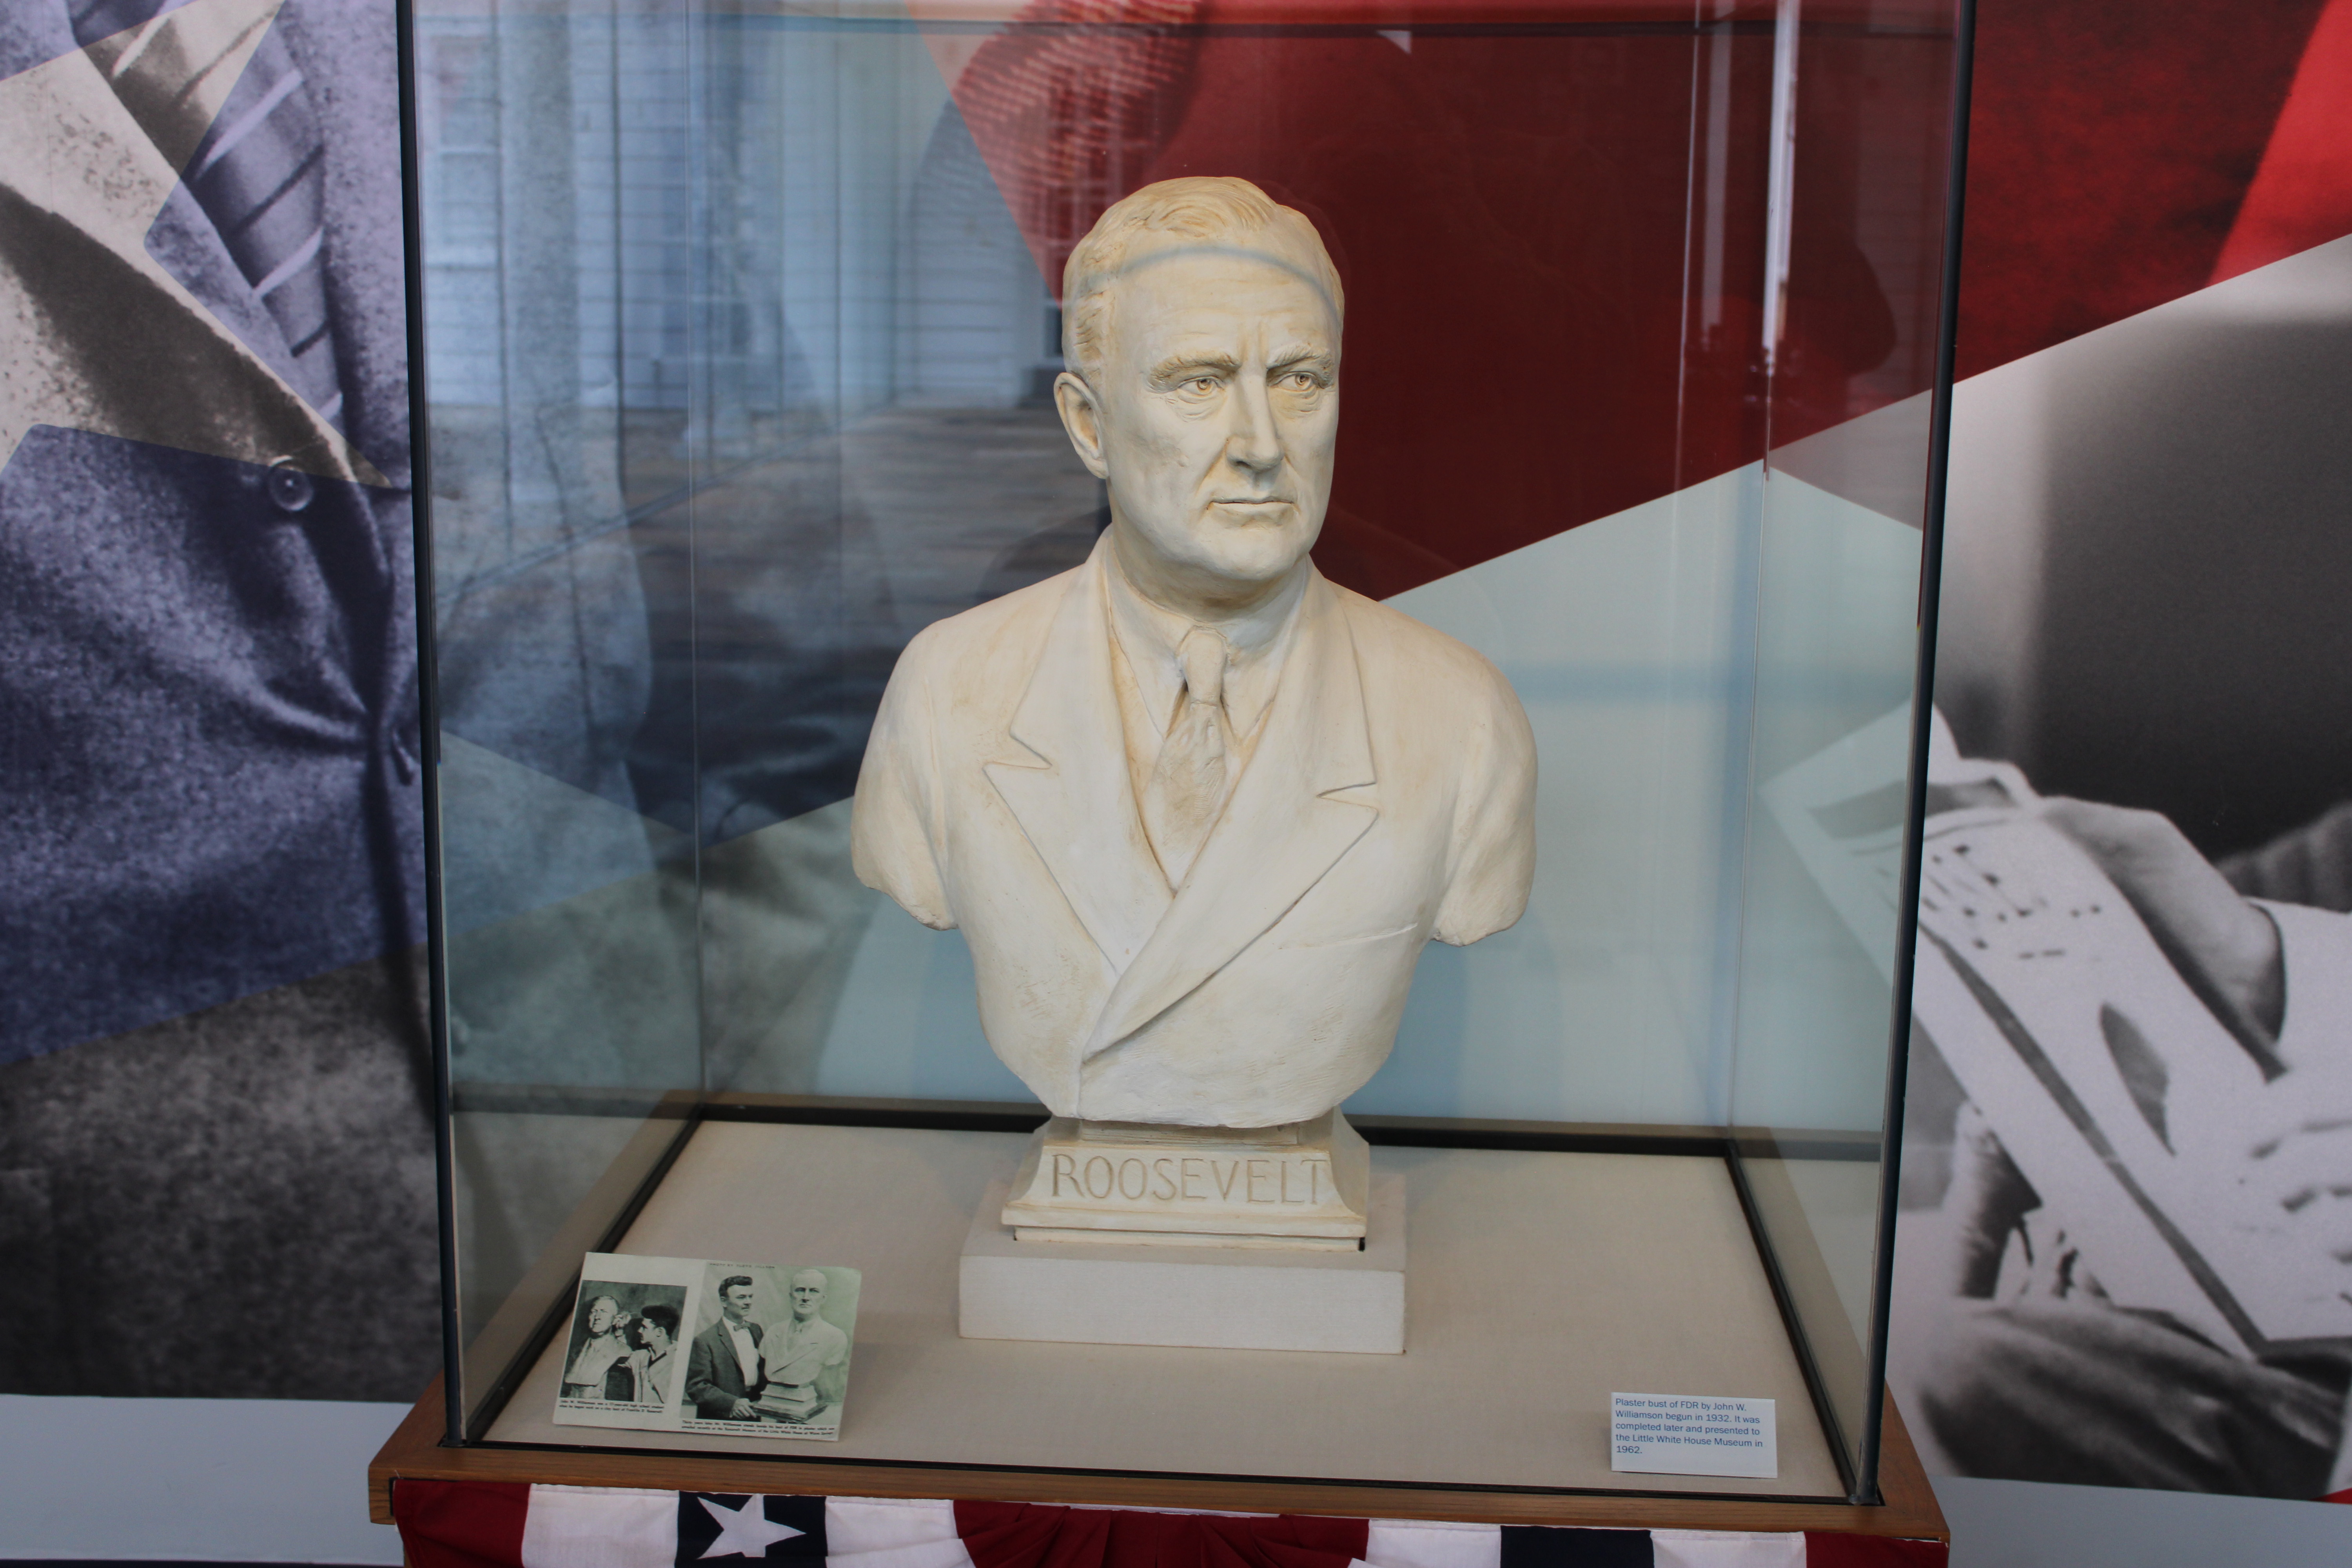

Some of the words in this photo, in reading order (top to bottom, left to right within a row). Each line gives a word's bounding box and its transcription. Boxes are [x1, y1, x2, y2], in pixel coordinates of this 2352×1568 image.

[1051, 1153, 1329, 1206] ROOSEVELT
[1616, 1398, 1646, 1406] Plaster
[1701, 1402, 1711, 1411] by
[1615, 1410, 1662, 1419] Williamson
[1666, 1412, 1692, 1421] begun
[1706, 1414, 1731, 1422] 1932.
[1714, 1438, 1752, 1446] Museum
